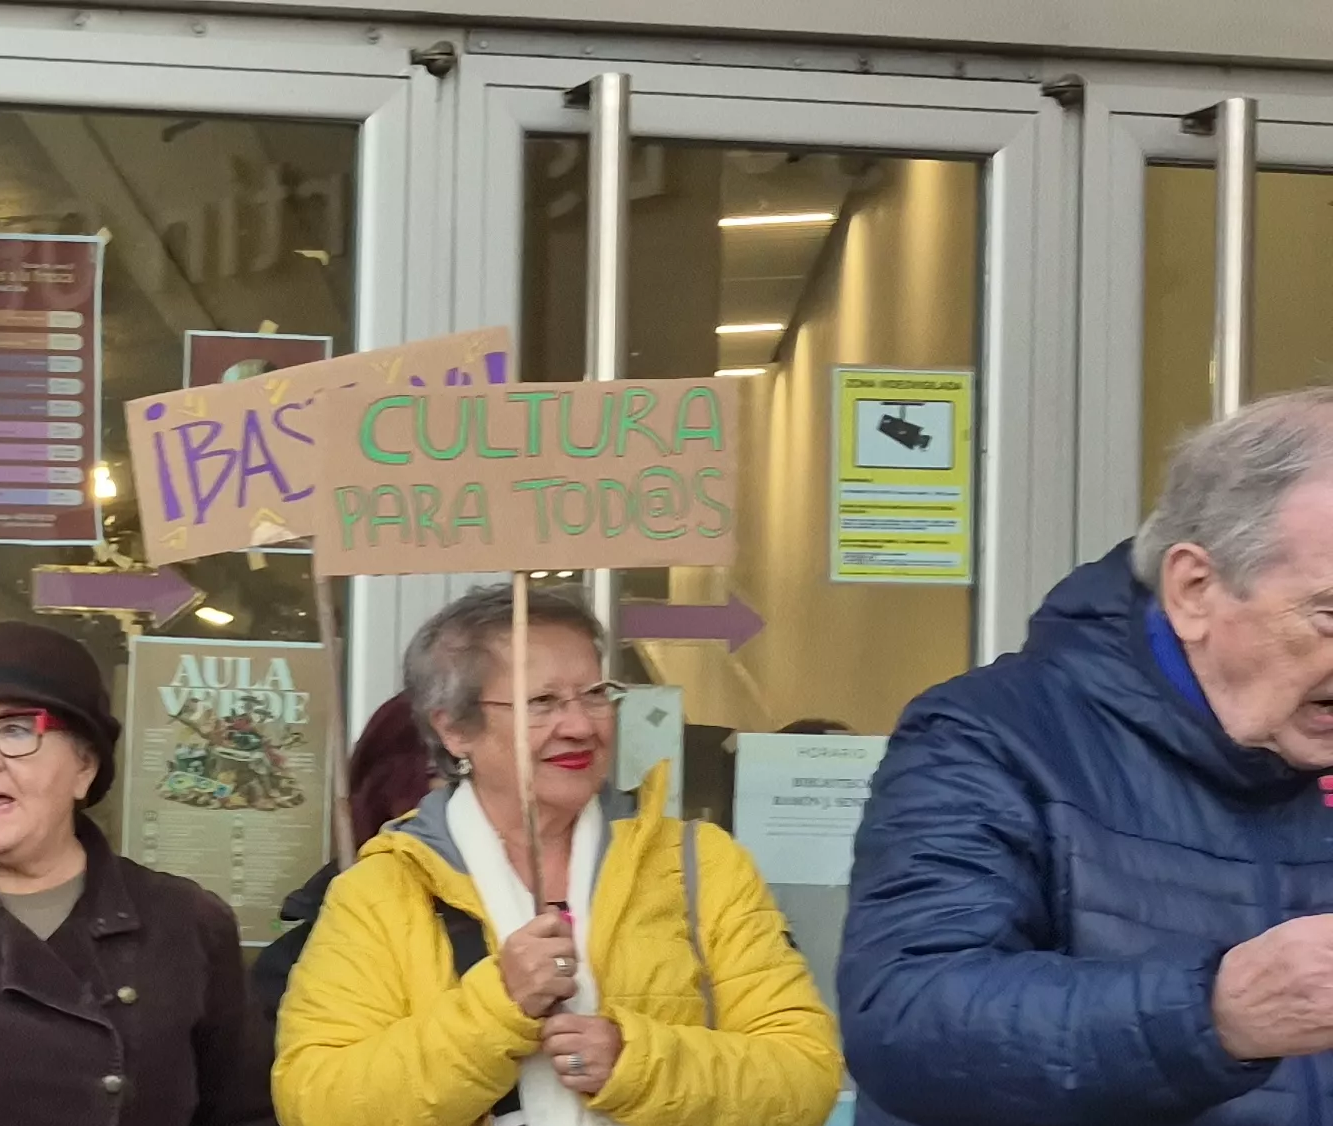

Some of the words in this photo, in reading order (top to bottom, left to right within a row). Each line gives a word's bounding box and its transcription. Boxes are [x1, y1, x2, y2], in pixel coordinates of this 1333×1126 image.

[358, 385, 723, 465] CULTURA
[334, 482, 493, 550] PARA
[511, 465, 732, 544] TOD@S
[169, 654, 296, 690] AULA
